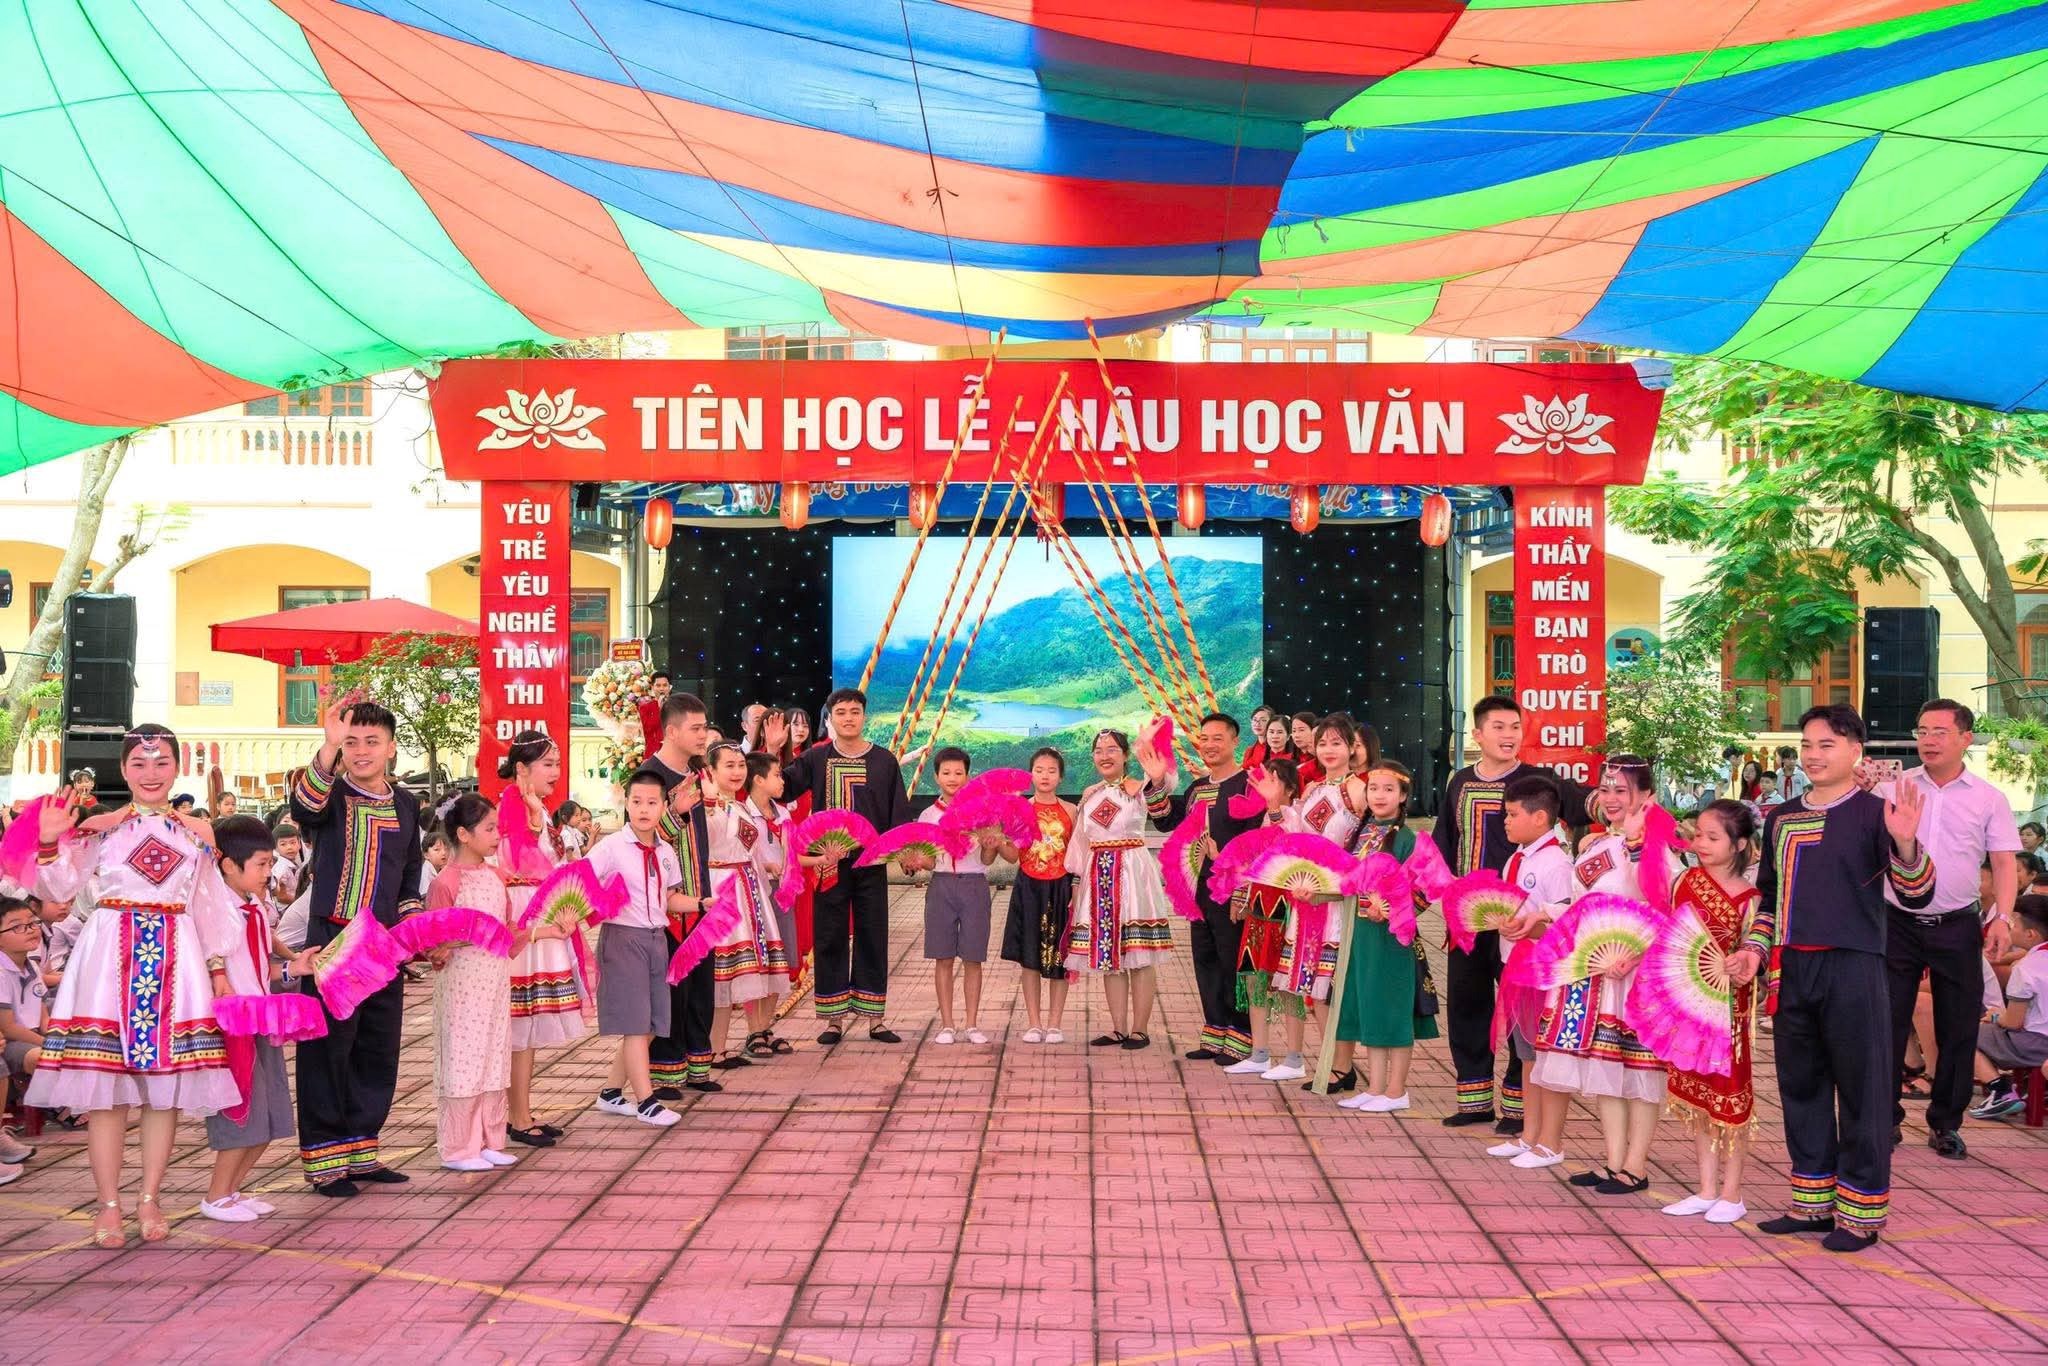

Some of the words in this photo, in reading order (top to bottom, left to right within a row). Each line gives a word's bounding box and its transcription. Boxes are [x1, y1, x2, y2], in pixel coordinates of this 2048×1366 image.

[632, 383, 763, 451] TIÊN
[783, 396, 904, 466] HỌC
[924, 374, 991, 453] LỄ
[1014, 420, 1036, 432] -
[1059, 386, 1180, 466] HẬU
[1202, 399, 1322, 468] HỌC
[1343, 388, 1464, 454] VĂN
[502, 498, 551, 525] YÊU
[1530, 501, 1593, 528] KÍNH
[500, 531, 547, 560] TRẺ
[1528, 536, 1592, 565] THẦY
[502, 571, 549, 596] YÊU
[1531, 572, 1590, 601] MẾN
[488, 605, 556, 633] NGHỀ
[1534, 617, 1588, 643] BẠN
[492, 640, 557, 669] THẦY
[1537, 649, 1587, 675] TRÒ
[504, 684, 544, 705] THI
[1521, 681, 1602, 712] QUYẾT
[1540, 721, 1584, 747] CHÍ
